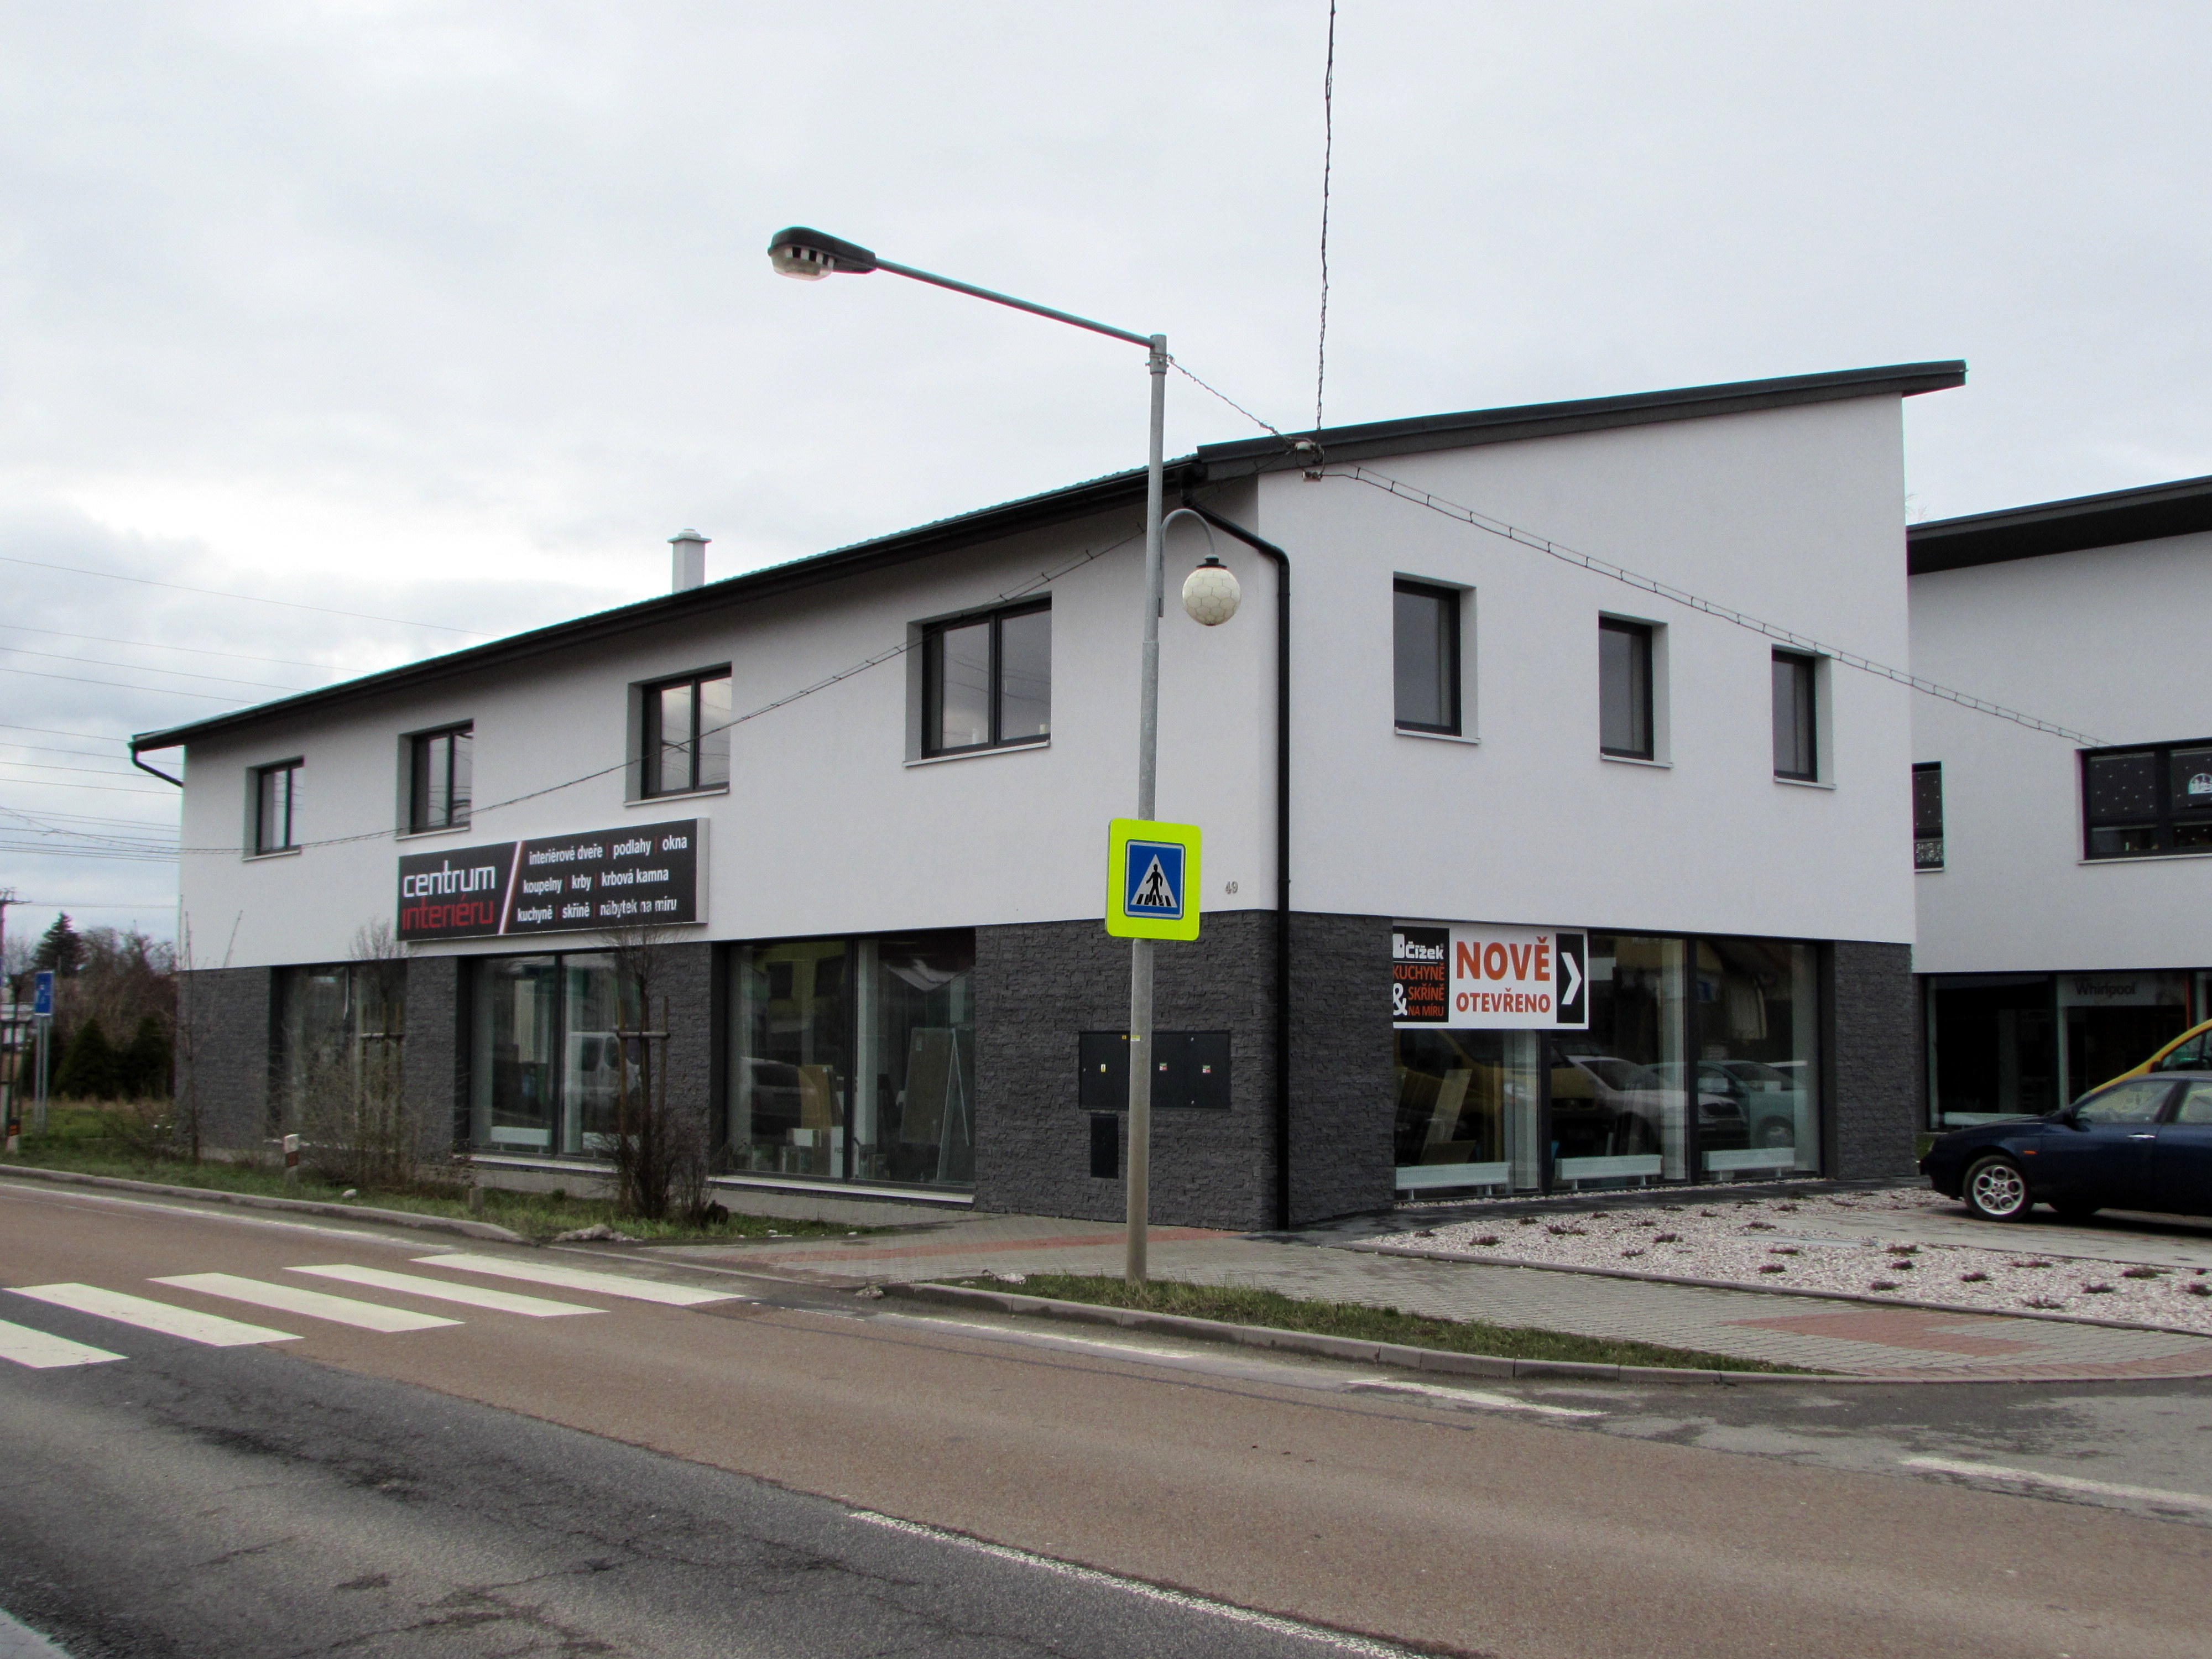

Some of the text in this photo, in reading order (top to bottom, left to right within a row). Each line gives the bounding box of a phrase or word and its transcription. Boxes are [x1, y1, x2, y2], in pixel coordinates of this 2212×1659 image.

[529, 835, 687, 865] interiérové dveře podlahy okna
[403, 860, 496, 898] centrum
[523, 868, 669, 895] koupelny krby krbová kamna
[402, 893, 494, 930] interiéru
[517, 895, 677, 924] kuchyně skříně nábytek na míru
[1393, 962, 1445, 980] KUCHYNĚ
[1456, 936, 1550, 981] NOVĚ
[1408, 983, 1444, 1001] SKŘÍNĚ
[1455, 988, 1551, 1013] OTEVŘENO
[2075, 982, 2137, 998] Whirlpool
[1408, 1003, 1444, 1016] NA MÍRU
